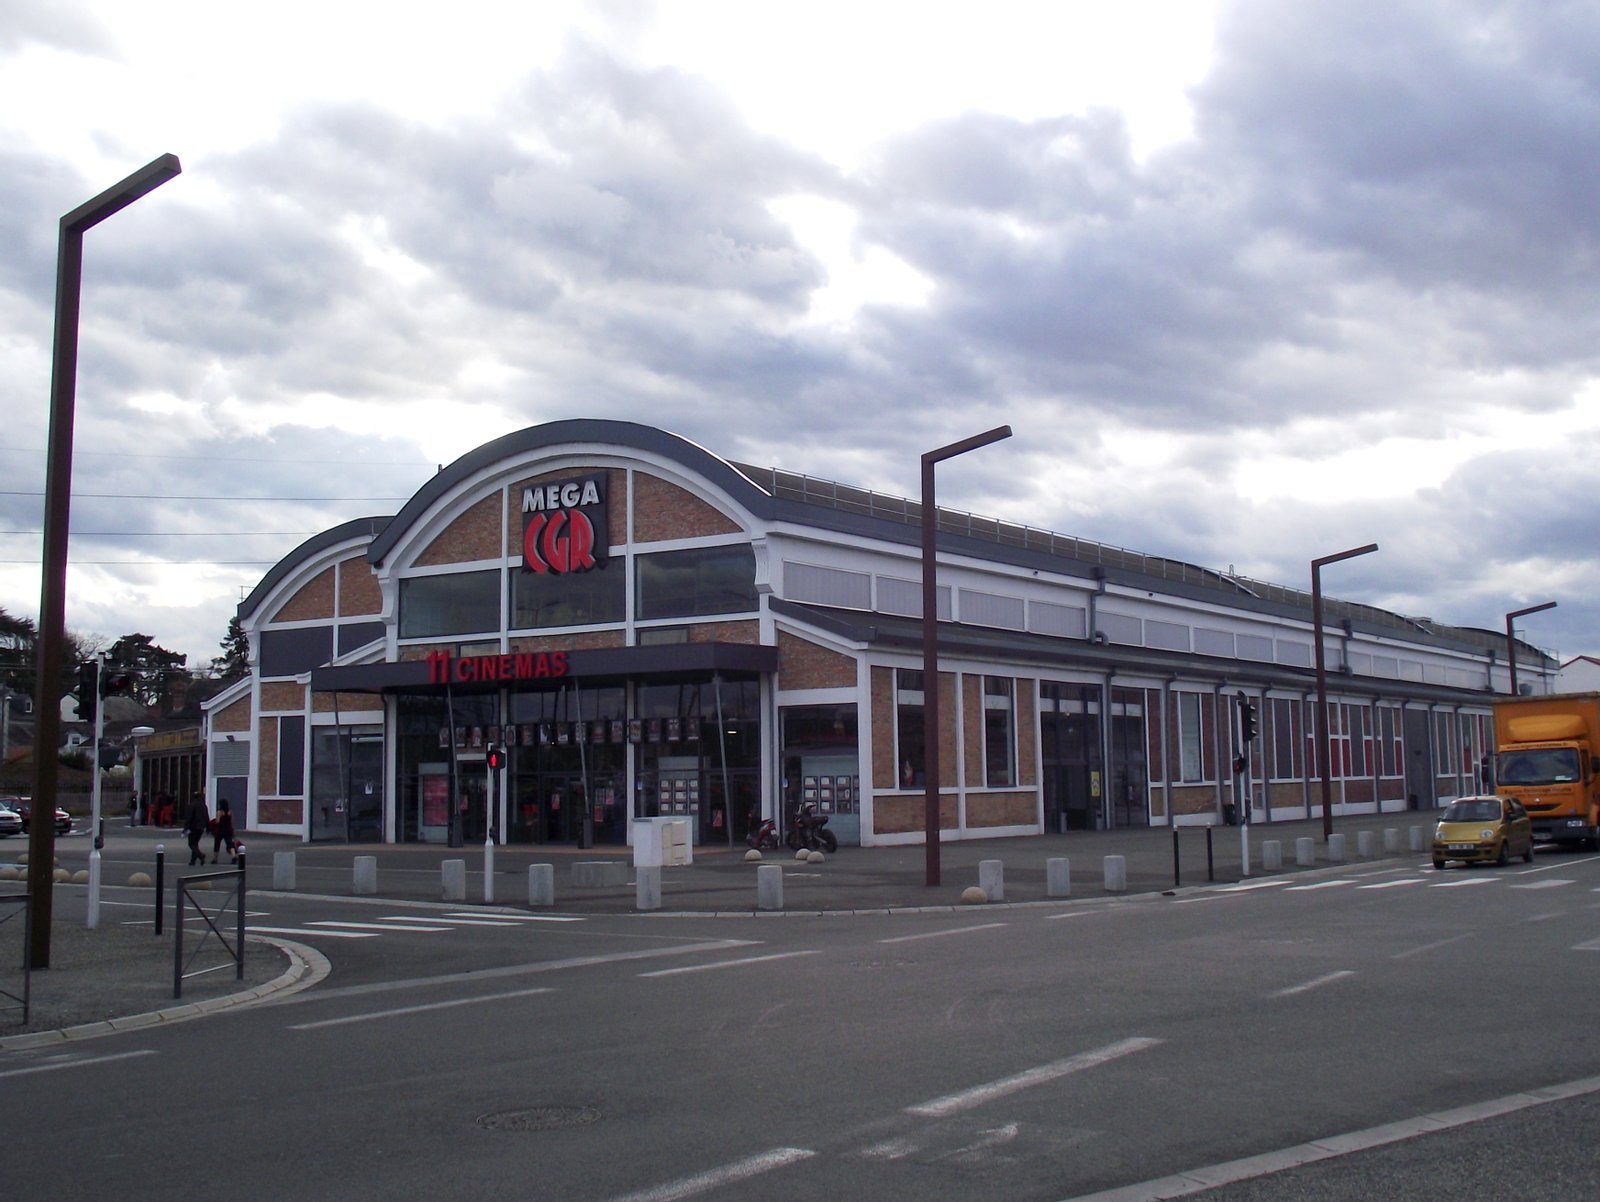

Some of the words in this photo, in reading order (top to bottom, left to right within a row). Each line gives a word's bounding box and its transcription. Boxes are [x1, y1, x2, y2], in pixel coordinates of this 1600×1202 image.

[522, 480, 600, 512] MEGA
[524, 508, 596, 575] CGR
[427, 650, 450, 684] 11
[455, 651, 568, 682] CINEMAS
